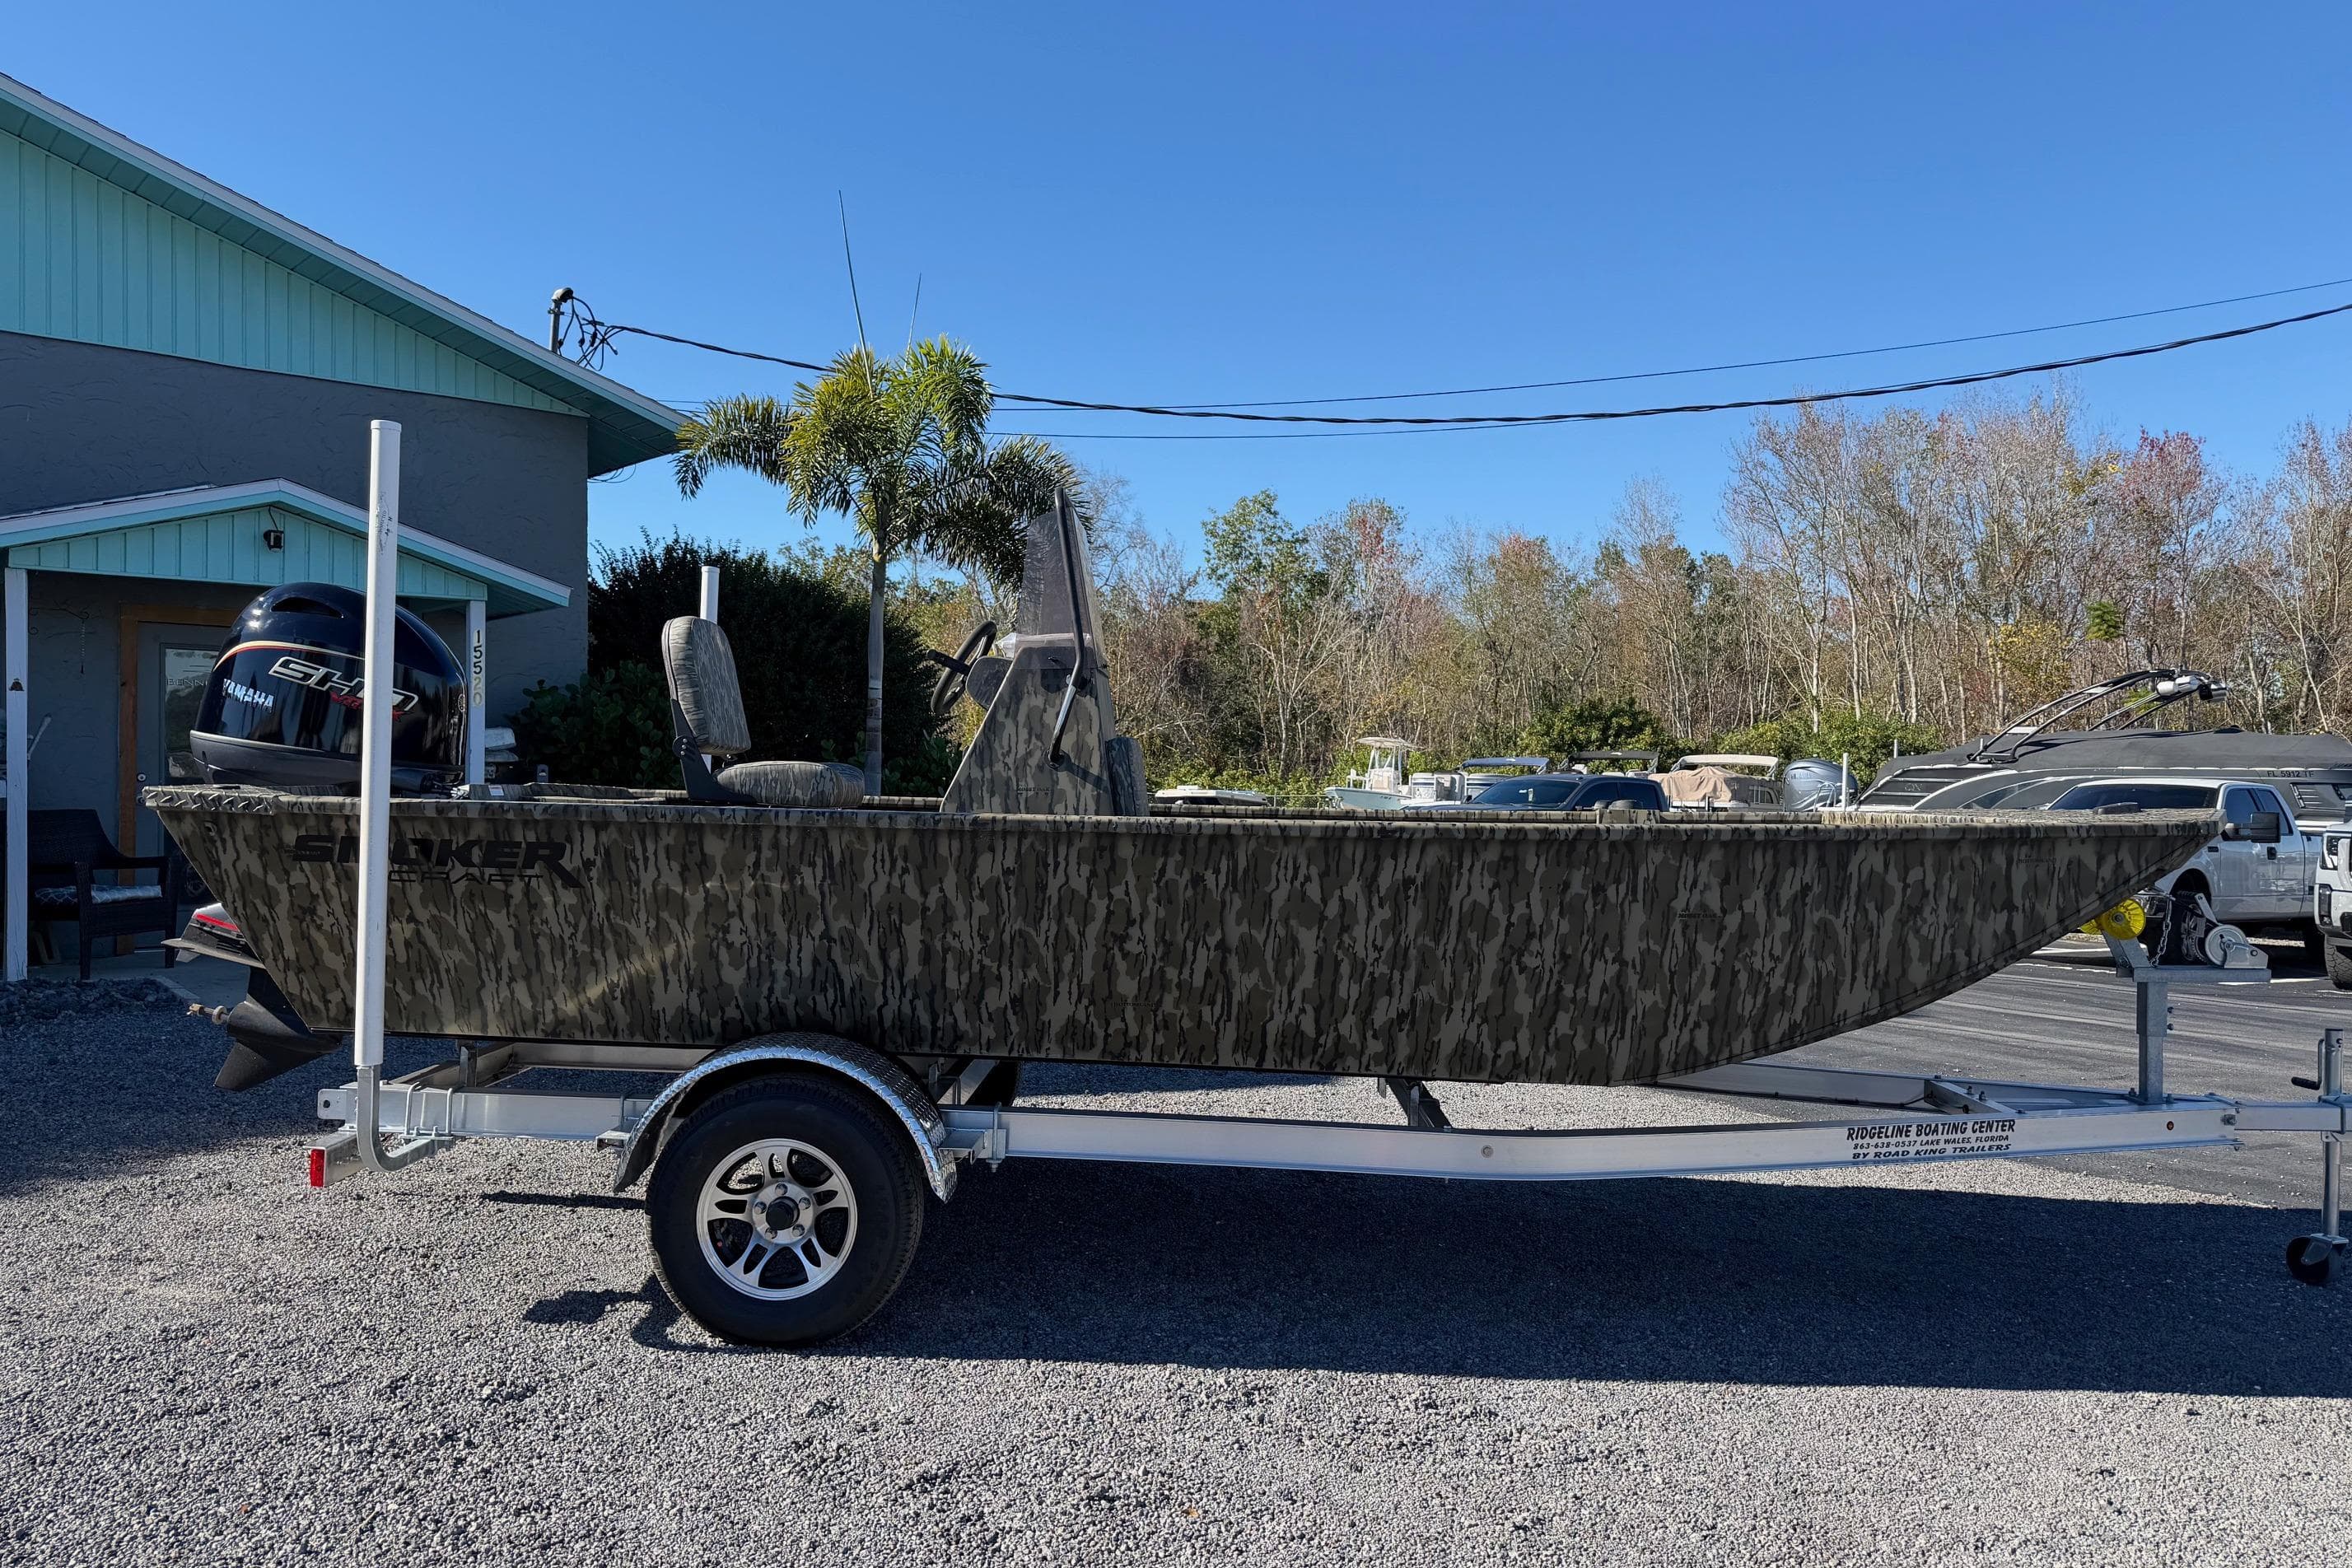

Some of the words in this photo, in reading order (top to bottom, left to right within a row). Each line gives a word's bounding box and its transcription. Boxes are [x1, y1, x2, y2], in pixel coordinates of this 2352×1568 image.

[473, 630, 483, 706] 15520
[222, 679, 274, 708] YAMAHA
[1846, 1125, 1912, 1141] RIDGELINE
[1916, 1122, 1967, 1136] BOATING
[1972, 1119, 2016, 1134] CENTER
[1853, 1140, 1917, 1150] 863-638-0537
[1920, 1138, 1941, 1146] LAKE
[1944, 1136, 1972, 1145] WALES,
[1975, 1135, 2009, 1143] FLORIDA
[1873, 1150, 1910, 1159] ROAD
[1914, 1148, 1947, 1156] KING
[1952, 1144, 2011, 1154] TRAILERS
